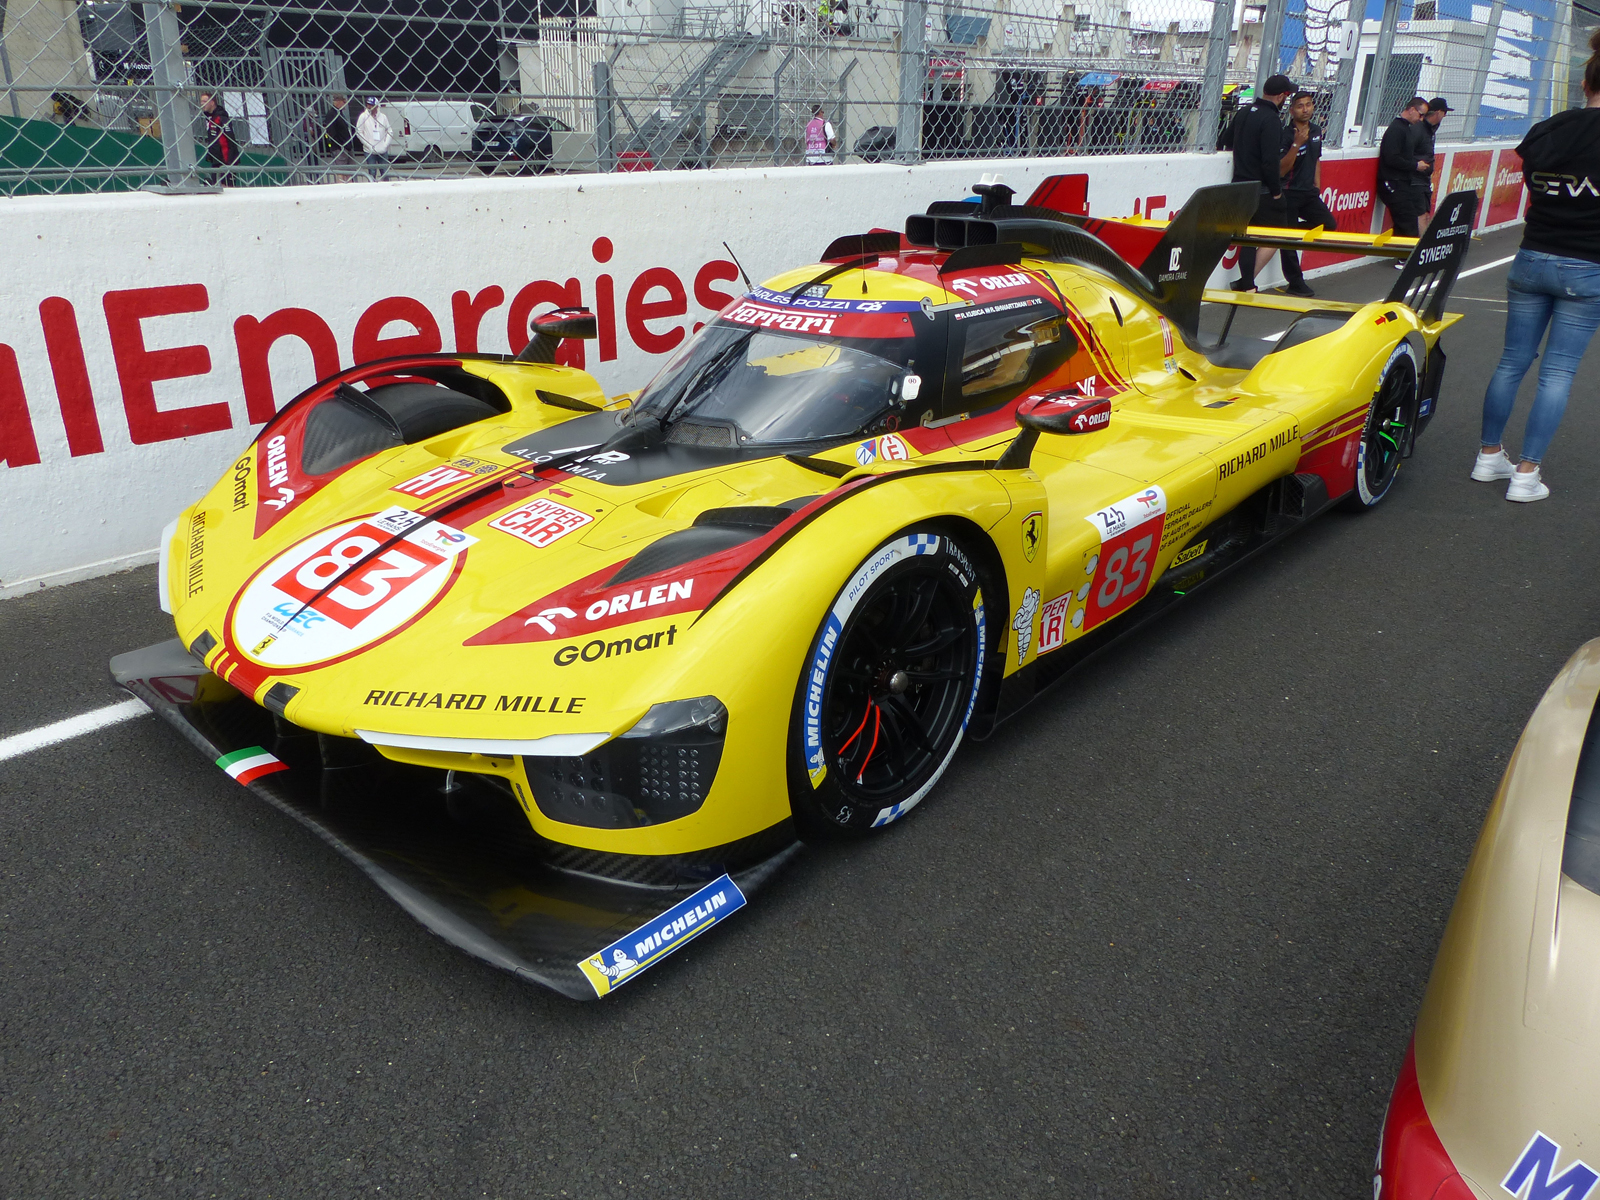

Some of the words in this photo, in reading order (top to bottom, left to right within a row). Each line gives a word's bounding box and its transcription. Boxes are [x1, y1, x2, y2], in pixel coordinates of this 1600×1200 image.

[1336, 190, 1370, 212] course
[980, 273, 1031, 290] ORLEN
[724, 302, 839, 334] Ferrari
[792, 298, 850, 310] POZZI
[1089, 410, 1110, 426] ORLEN
[267, 435, 288, 488] ORLEN
[1219, 442, 1267, 481] RICHARD
[1270, 425, 1298, 453] MILLE
[233, 457, 251, 512] GOmart
[394, 466, 474, 496] HY
[499, 511, 565, 543] CAR
[525, 501, 585, 528] HYPER
[1166, 503, 1191, 520] OFFICIAL
[190, 511, 206, 560] RICHARD
[189, 559, 203, 598] MILLE
[296, 535, 428, 610] 83
[848, 573, 869, 601] PILOT
[869, 550, 895, 576] SPORT
[944, 536, 977, 583] TRANSPORT
[1097, 533, 1153, 608] 83
[585, 579, 694, 622] ORLEN
[553, 625, 678, 667] GOmart
[808, 625, 838, 747] MICHELIN
[966, 625, 986, 725] MICHELIN
[363, 689, 487, 711] RICHARD
[494, 695, 586, 714] MILLE
[634, 890, 727, 959] MICHELIN
